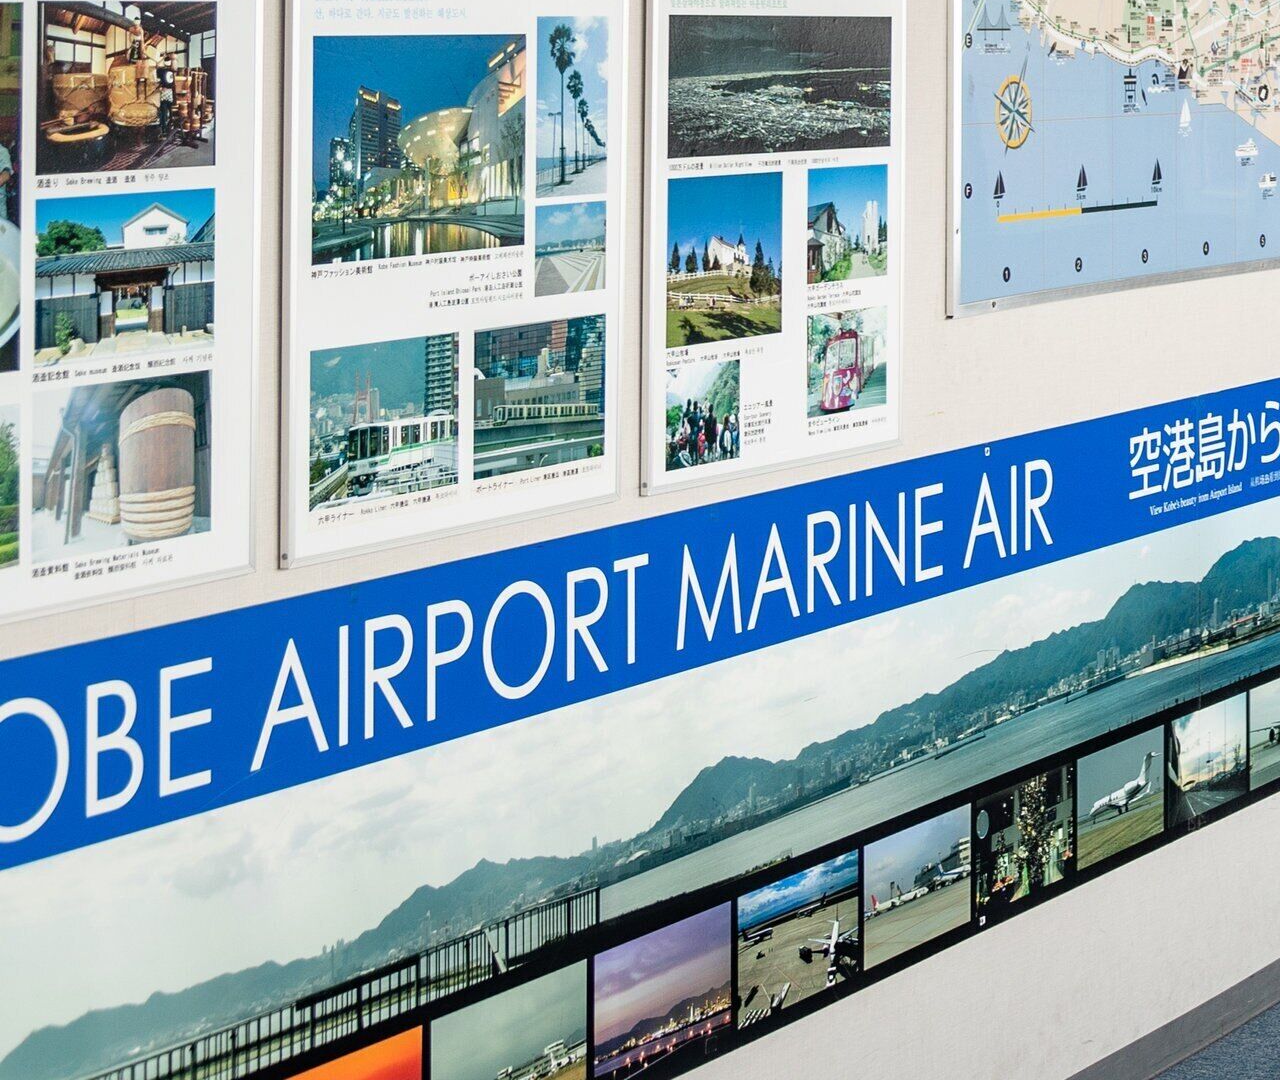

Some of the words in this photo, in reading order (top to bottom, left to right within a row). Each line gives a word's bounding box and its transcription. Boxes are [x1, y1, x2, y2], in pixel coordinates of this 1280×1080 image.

[1075, 191, 1086, 201] 5km
[1150, 185, 1163, 194] 10km
[1149, 500, 1163, 517] View
[1180, 492, 1198, 510] beauty
[1209, 486, 1228, 502] Airport
[1228, 481, 1243, 496] Island
[249, 553, 650, 774] AIRPORT
[677, 490, 944, 651] MARINE
[962, 458, 1054, 569] AIR
